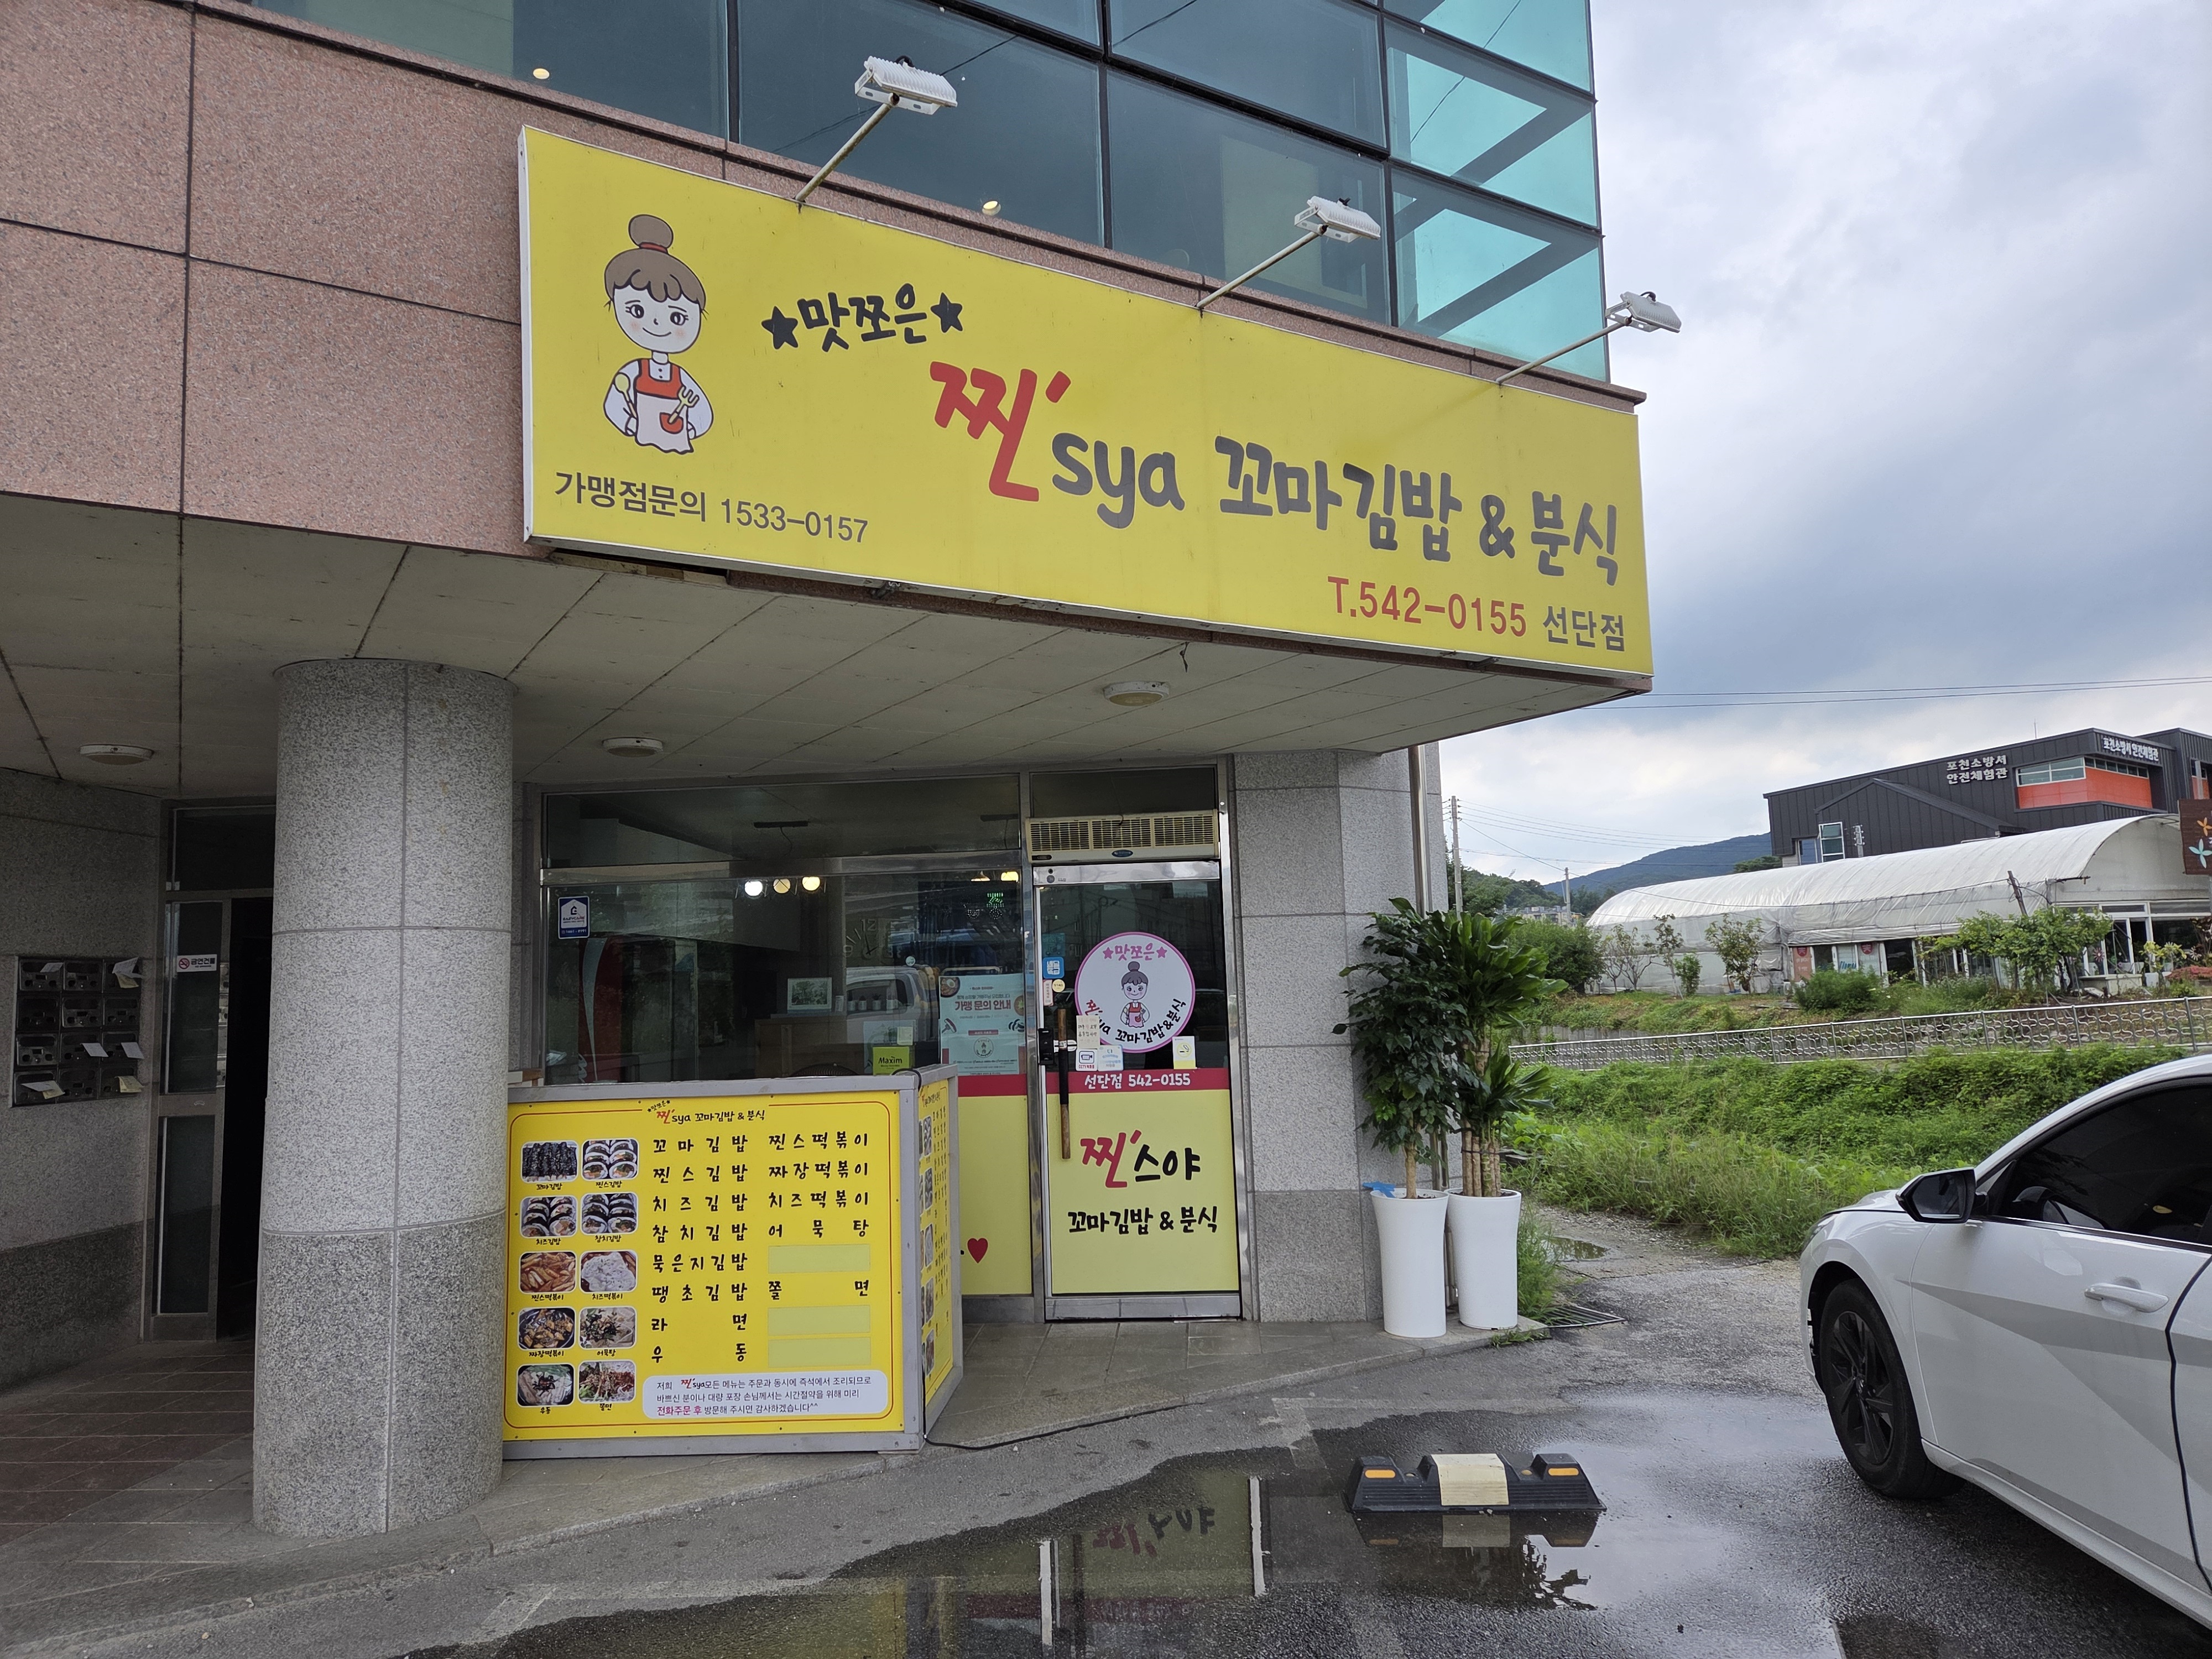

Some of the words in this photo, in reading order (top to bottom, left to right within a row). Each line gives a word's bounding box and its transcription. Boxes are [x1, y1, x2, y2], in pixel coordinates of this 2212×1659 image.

[797, 283, 927, 352] 맛쪼은
[554, 471, 707, 522] 가맹점문의
[721, 498, 868, 544] 1533-0157
[1214, 435, 1462, 563] 꼬마김밥
[1479, 494, 1515, 559] &
[1531, 491, 1619, 586] 분식
[1327, 576, 1526, 637] T.542-0155
[1542, 604, 1626, 651] 선단점
[1946, 755, 2007, 771] 포천소방서
[1946, 767, 2008, 785] 안전체험관
[1114, 942, 1155, 961] 맛쪼은
[954, 1000, 973, 1011] 가맹
[974, 1000, 992, 1010] 문의
[993, 999, 1011, 1010] 안내
[878, 1056, 902, 1064] Maxim
[1084, 1073, 1123, 1089] 선단점
[1128, 1073, 1191, 1087] 542-0155
[695, 1111, 735, 1122] 꼬마김밥
[747, 1110, 765, 1121] 분식
[595, 1180, 623, 1188] 찐스김밥
[1068, 1207, 1154, 1235] 꼬마김밥
[1159, 1211, 1174, 1230] &
[1180, 1206, 1217, 1233] 분식
[595, 1235, 622, 1243] 참치김밥
[656, 1381, 672, 1390] 저희
[722, 1379, 745, 1389] 메뉴는
[748, 1379, 771, 1388] 주문과
[774, 1378, 797, 1387] 동시에
[800, 1376, 830, 1387] 즉석에서
[832, 1376, 872, 1386] 조리되므로
[656, 1394, 680, 1404] 바쁘신
[682, 1393, 705, 1403] 분이나
[708, 1392, 723, 1402] 대량
[726, 1392, 741, 1401] 포장
[743, 1391, 782, 1401] 손님께서는
[785, 1389, 823, 1400] 시간절약을
[826, 1389, 842, 1399] 위해
[844, 1389, 859, 1398] 미리
[539, 1406, 551, 1415] 우동
[656, 1405, 691, 1416] 전화주문
[693, 1405, 702, 1416] 후
[704, 1405, 727, 1415] 방문해
[729, 1404, 753, 1414] 주시면
